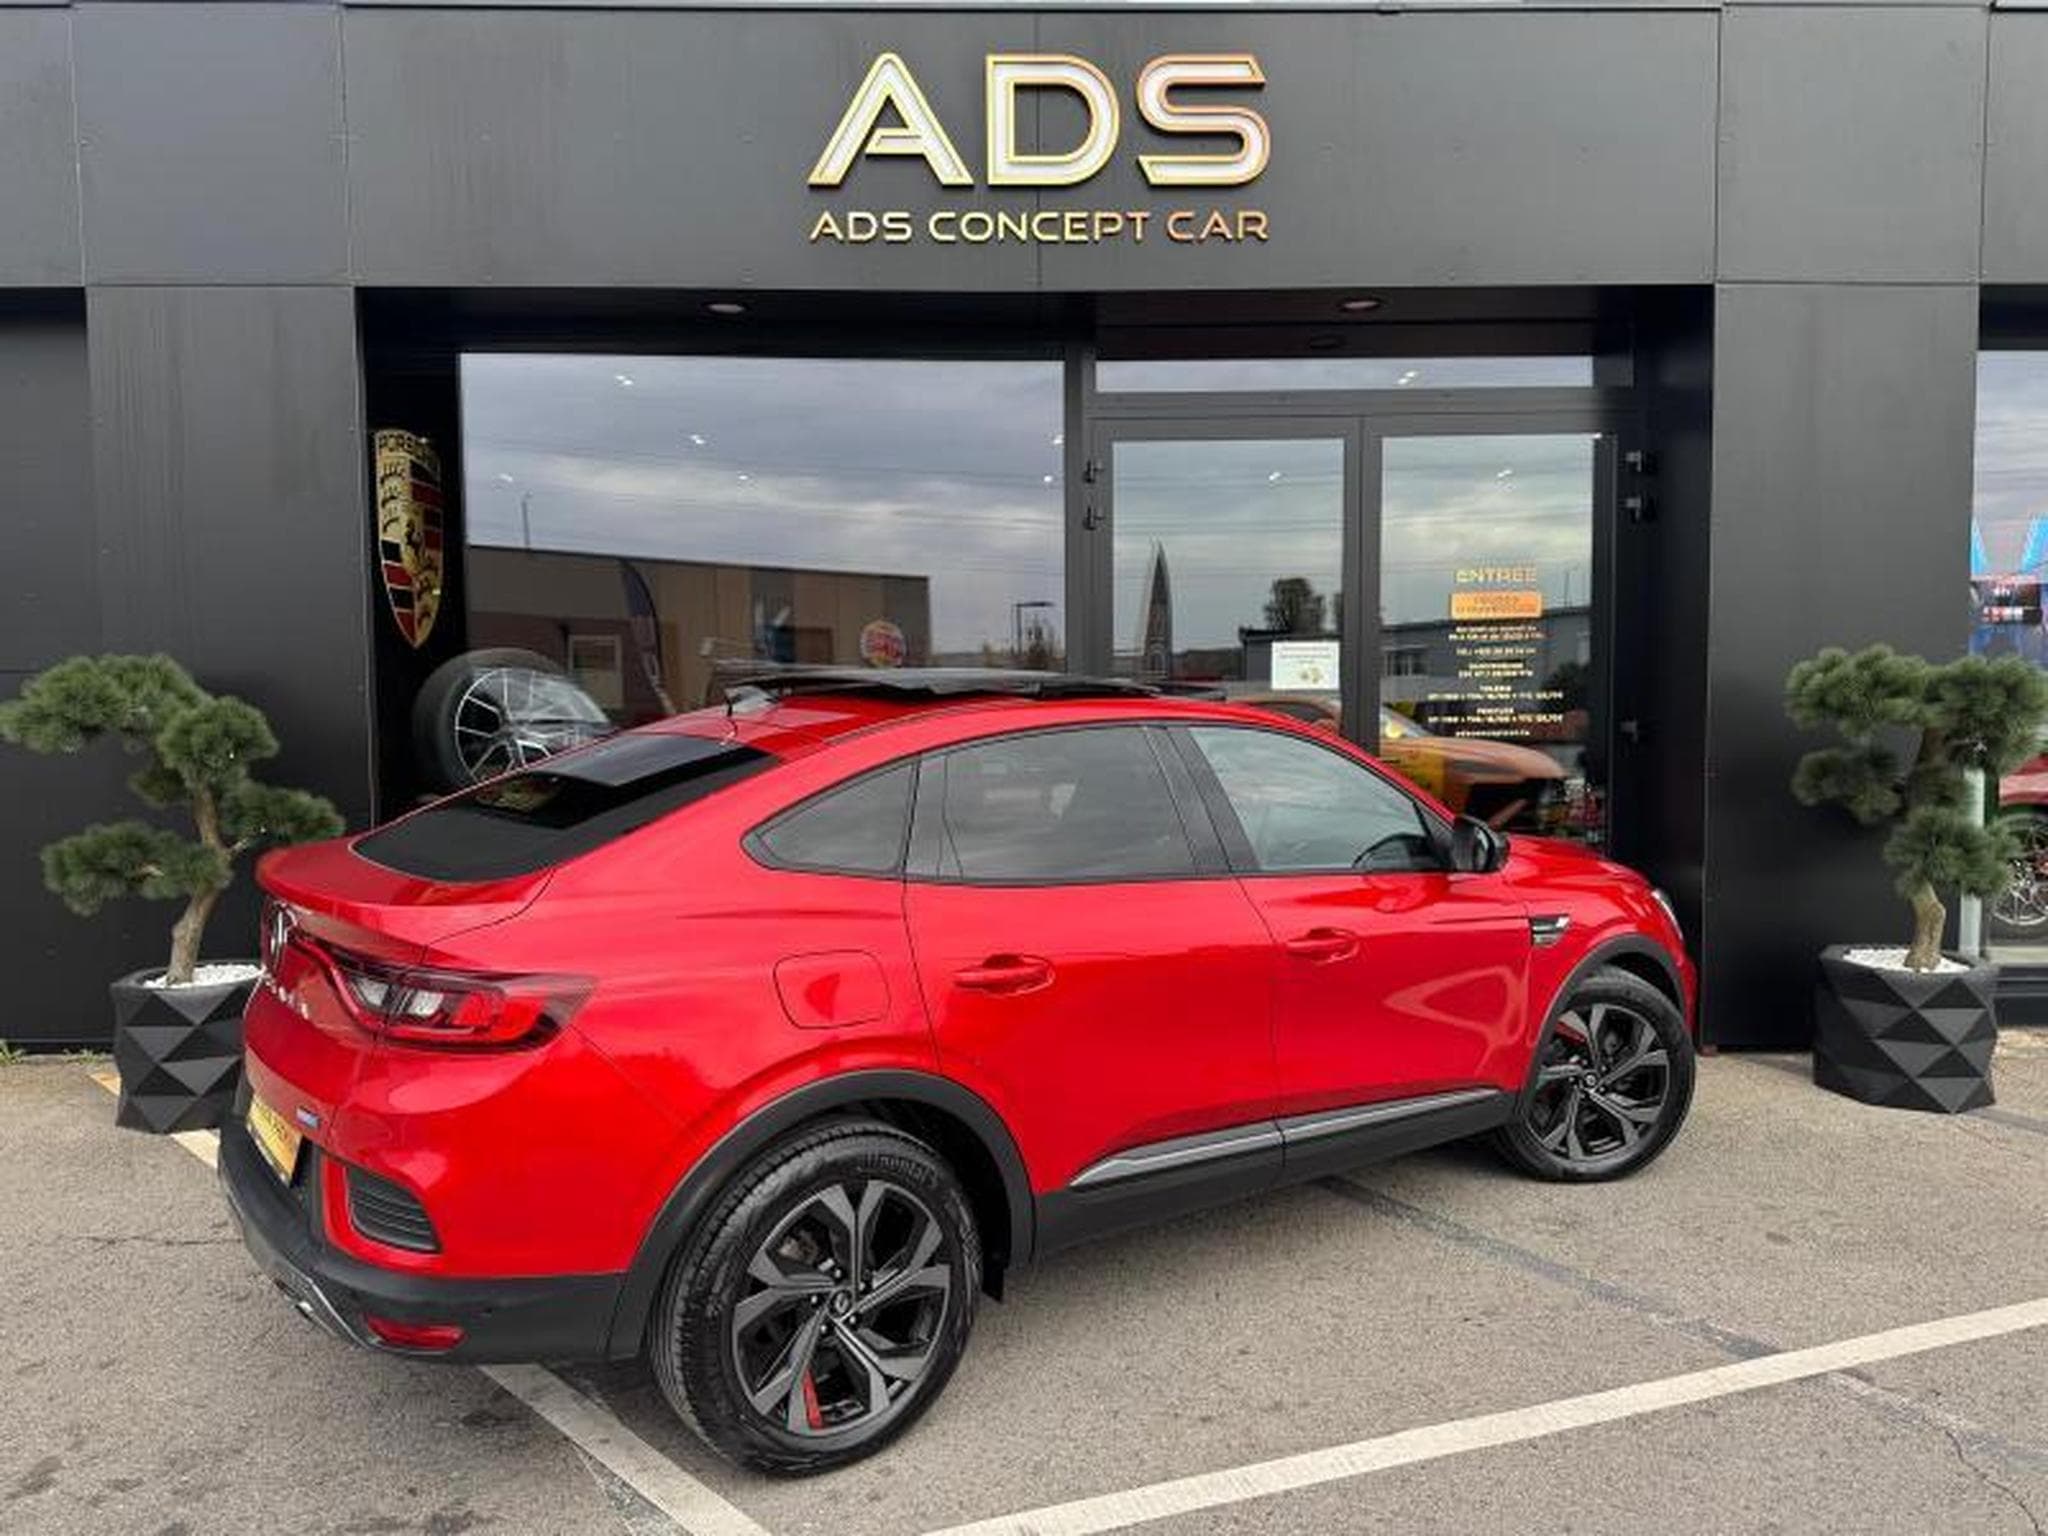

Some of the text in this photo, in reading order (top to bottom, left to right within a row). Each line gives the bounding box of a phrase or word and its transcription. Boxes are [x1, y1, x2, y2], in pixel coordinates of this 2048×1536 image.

[808, 52, 1272, 187] ADS
[810, 210, 1269, 243] ADS CONCEPT CAR
